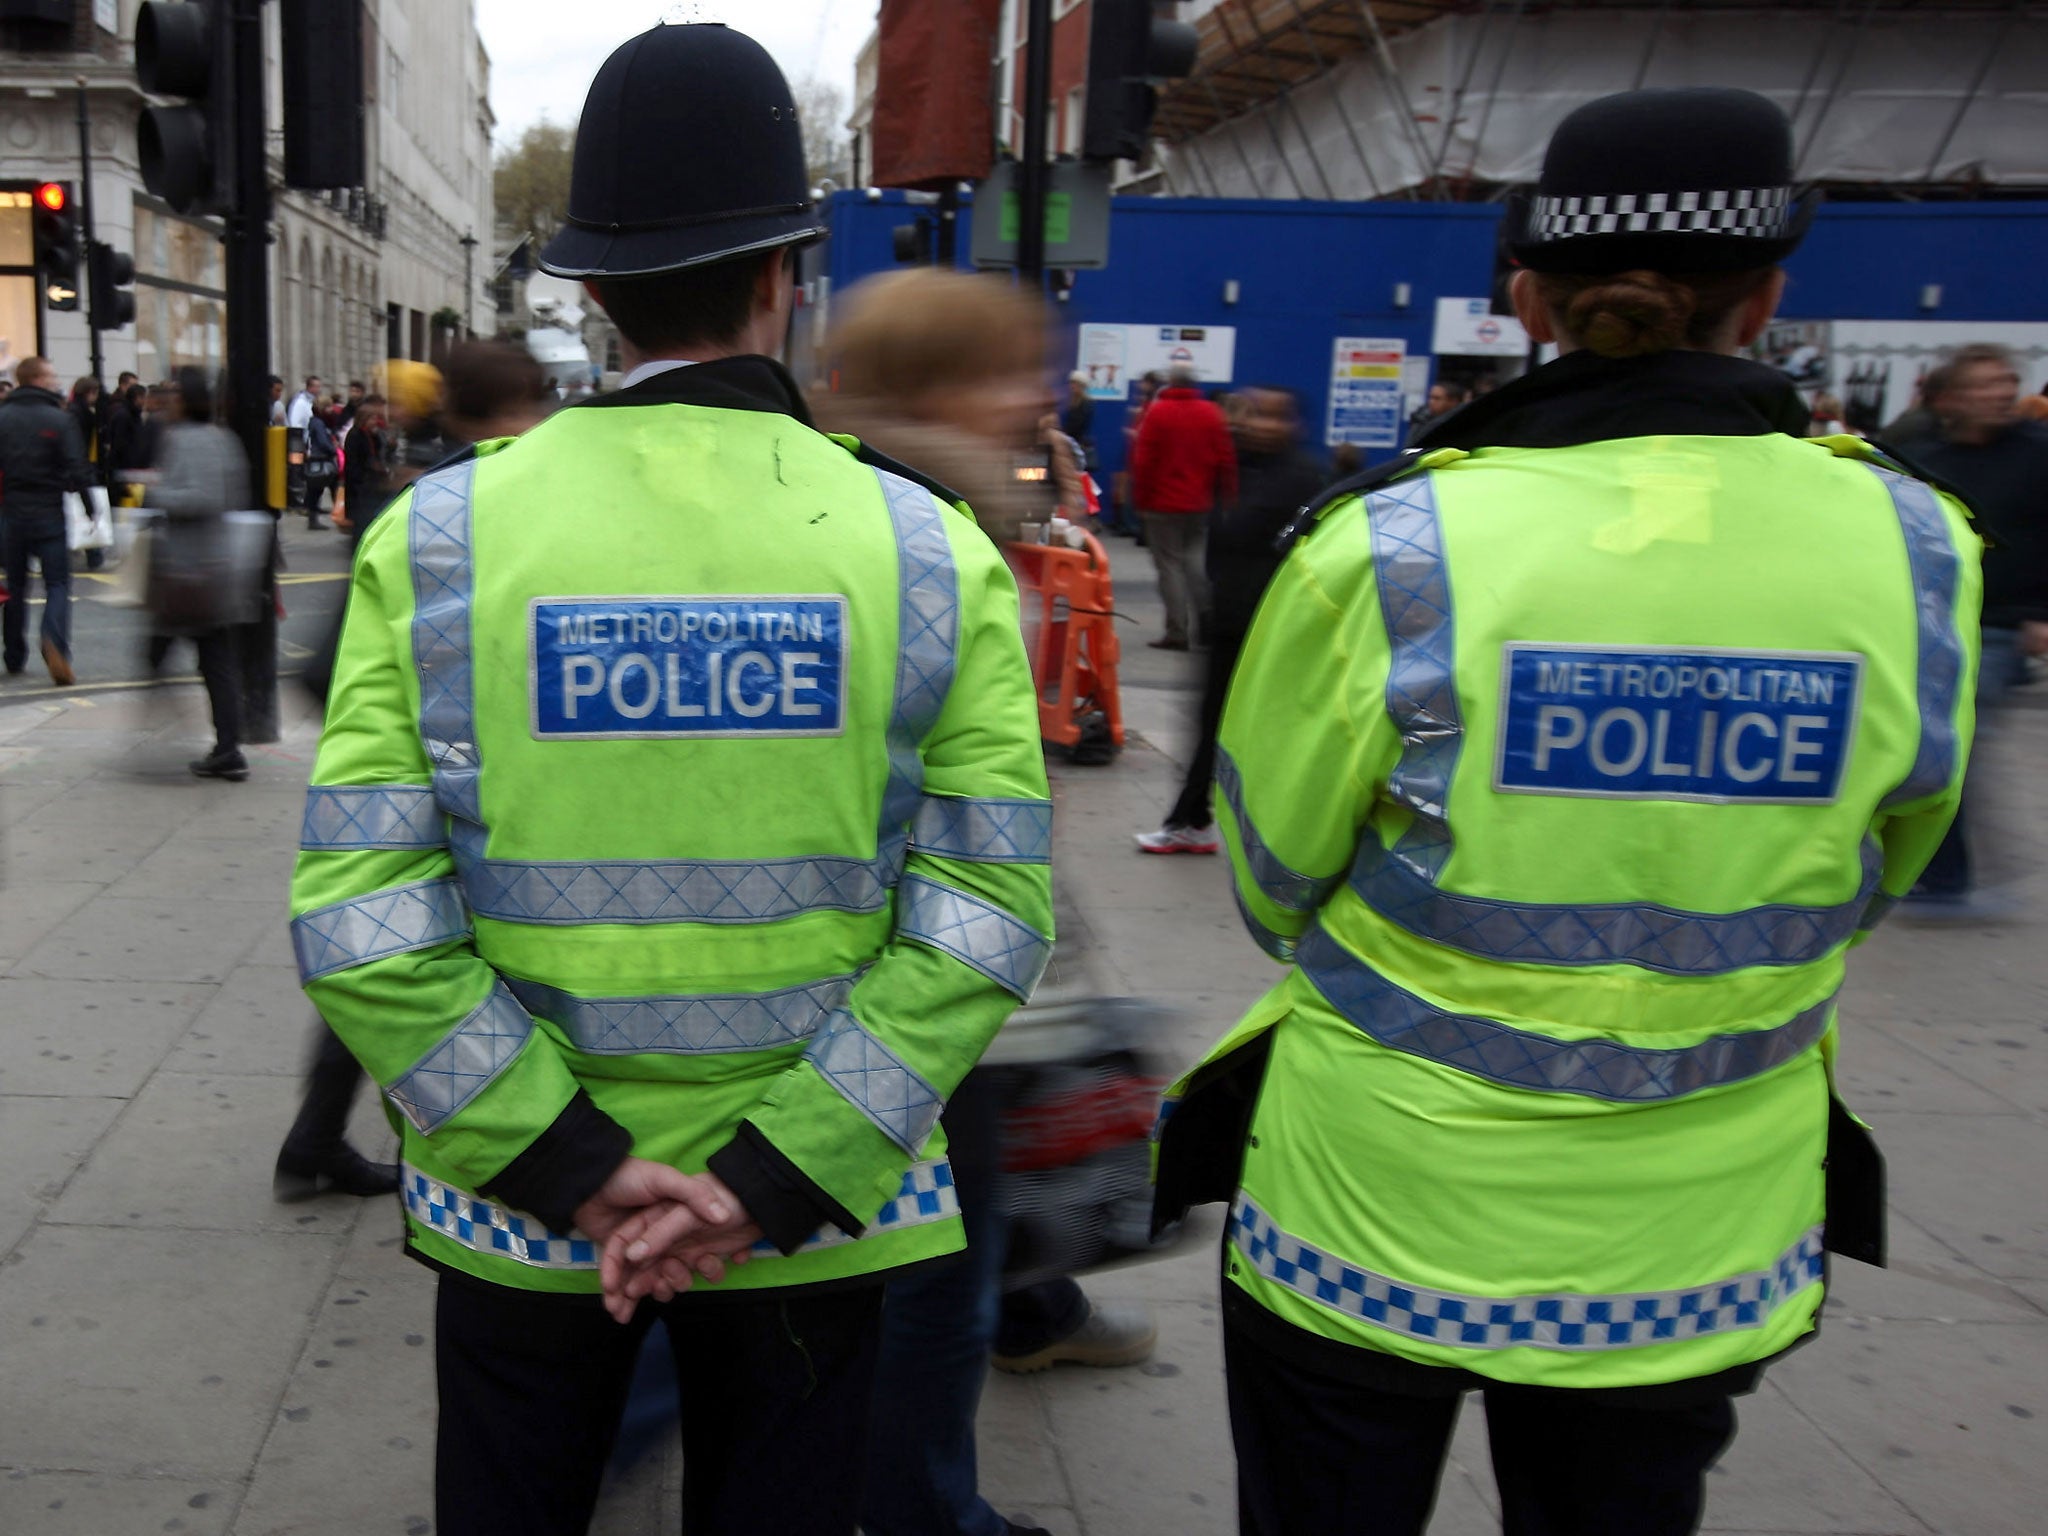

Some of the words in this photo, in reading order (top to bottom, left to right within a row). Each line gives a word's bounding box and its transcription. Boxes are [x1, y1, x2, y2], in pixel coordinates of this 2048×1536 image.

[559, 611, 823, 644] METROPOLITAN
[562, 651, 822, 719] POLICE
[1536, 661, 1834, 705] METROPOLITAN
[1532, 705, 1829, 783] POLICE
